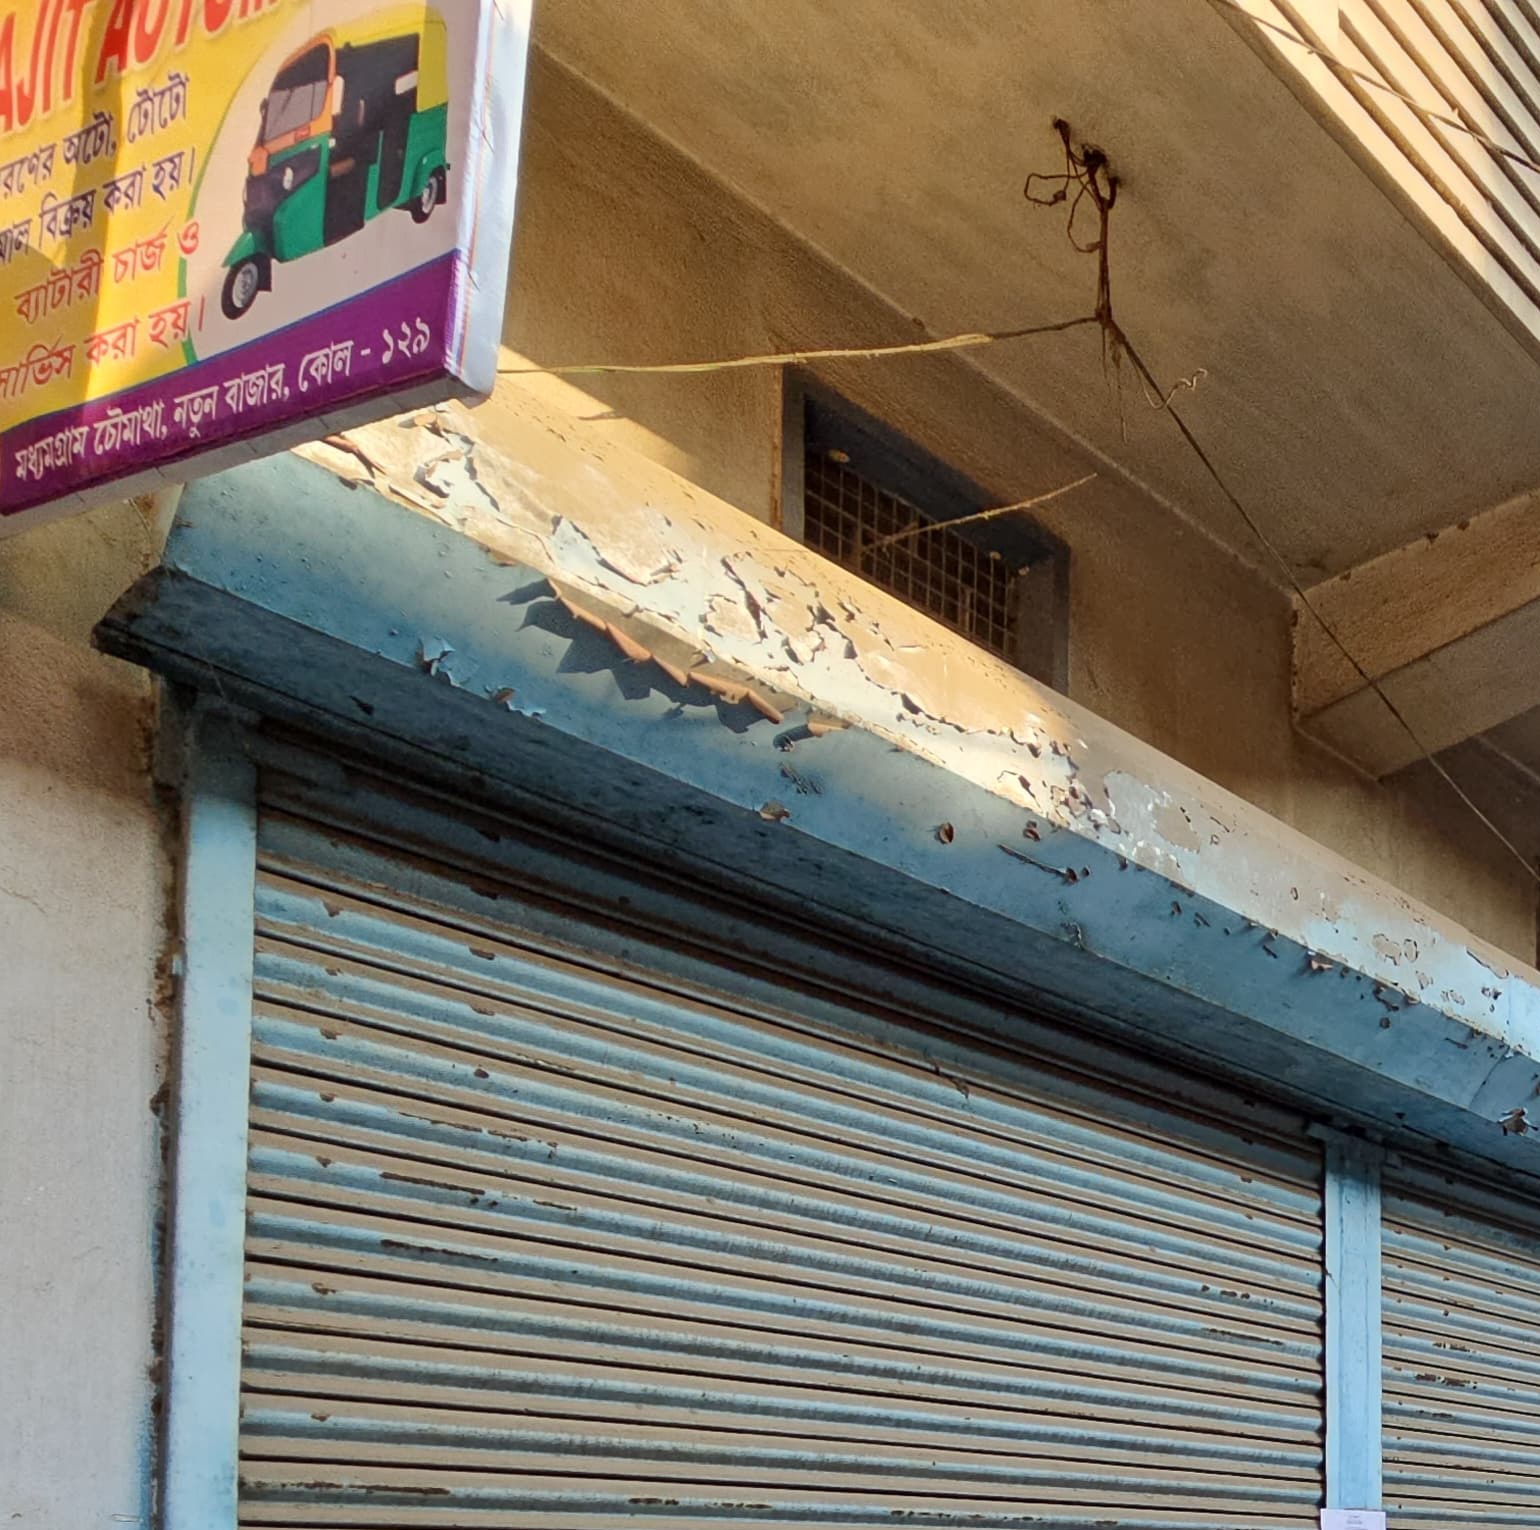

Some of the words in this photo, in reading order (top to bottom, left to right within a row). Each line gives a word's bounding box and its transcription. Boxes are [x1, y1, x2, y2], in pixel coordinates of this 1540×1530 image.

[0, 143, 57, 199] রণের
[127, 73, 190, 143] টোটো
[102, 164, 146, 213] করা
[112, 216, 175, 283] চার্জ
[177, 221, 200, 254] ও
[84, 316, 140, 367] করা
[174, 385, 219, 438] নতুন
[223, 363, 290, 414] বাজার,
[299, 340, 354, 392] কোল
[382, 317, 431, 364] ১২৯
